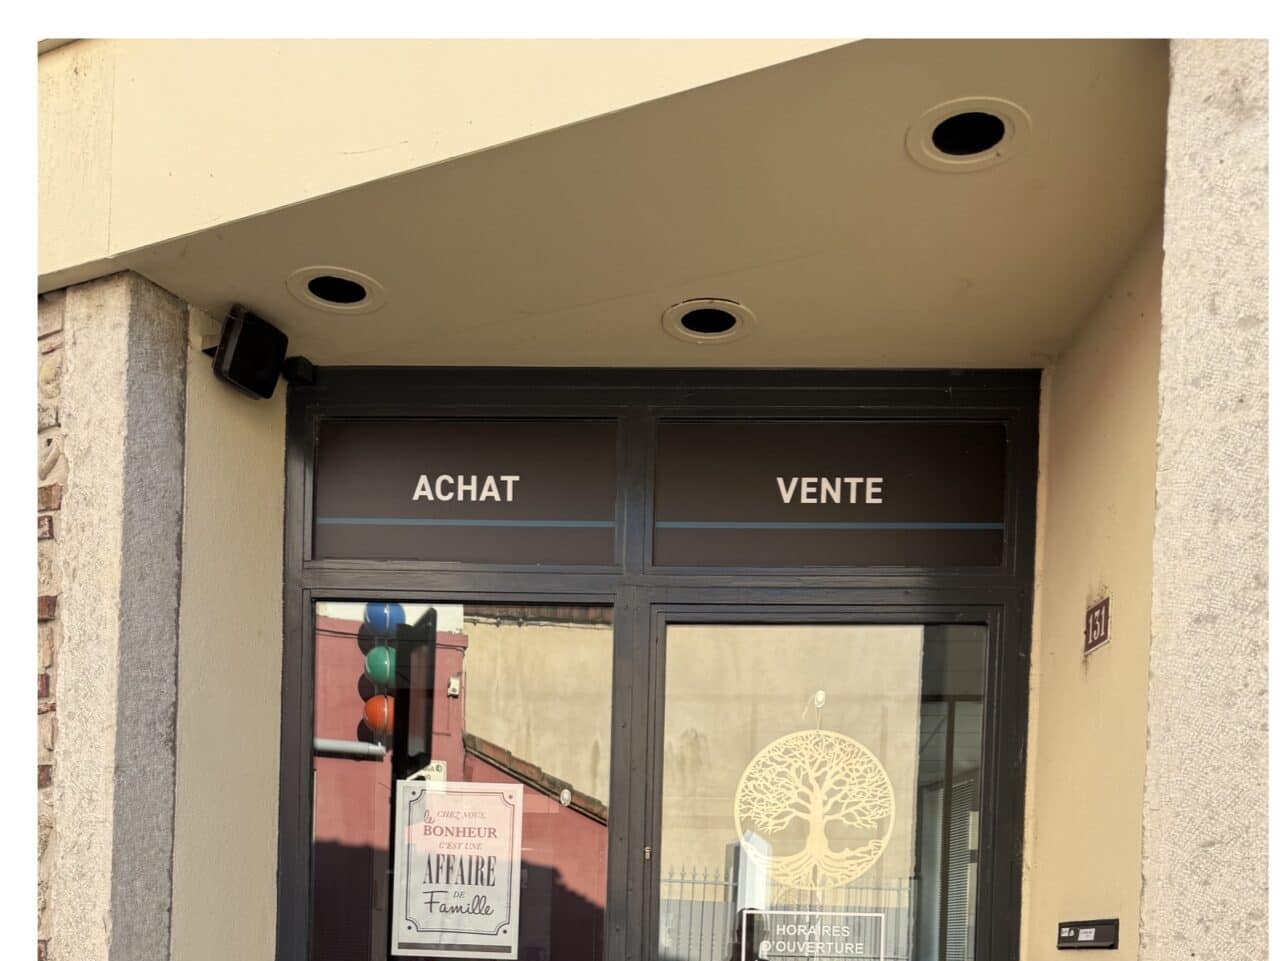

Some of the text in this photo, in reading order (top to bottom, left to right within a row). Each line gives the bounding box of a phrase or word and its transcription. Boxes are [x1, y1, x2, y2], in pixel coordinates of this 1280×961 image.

[412, 474, 520, 502] ACHAT
[776, 477, 883, 504] VENTE
[423, 825, 498, 839] BONHEUR
[422, 853, 497, 888] AFFAIRE
[422, 890, 494, 916] Famille
[453, 890, 465, 899] DE
[776, 924, 850, 937] HORAIRES
[761, 940, 864, 954] D'OUVERTURE
